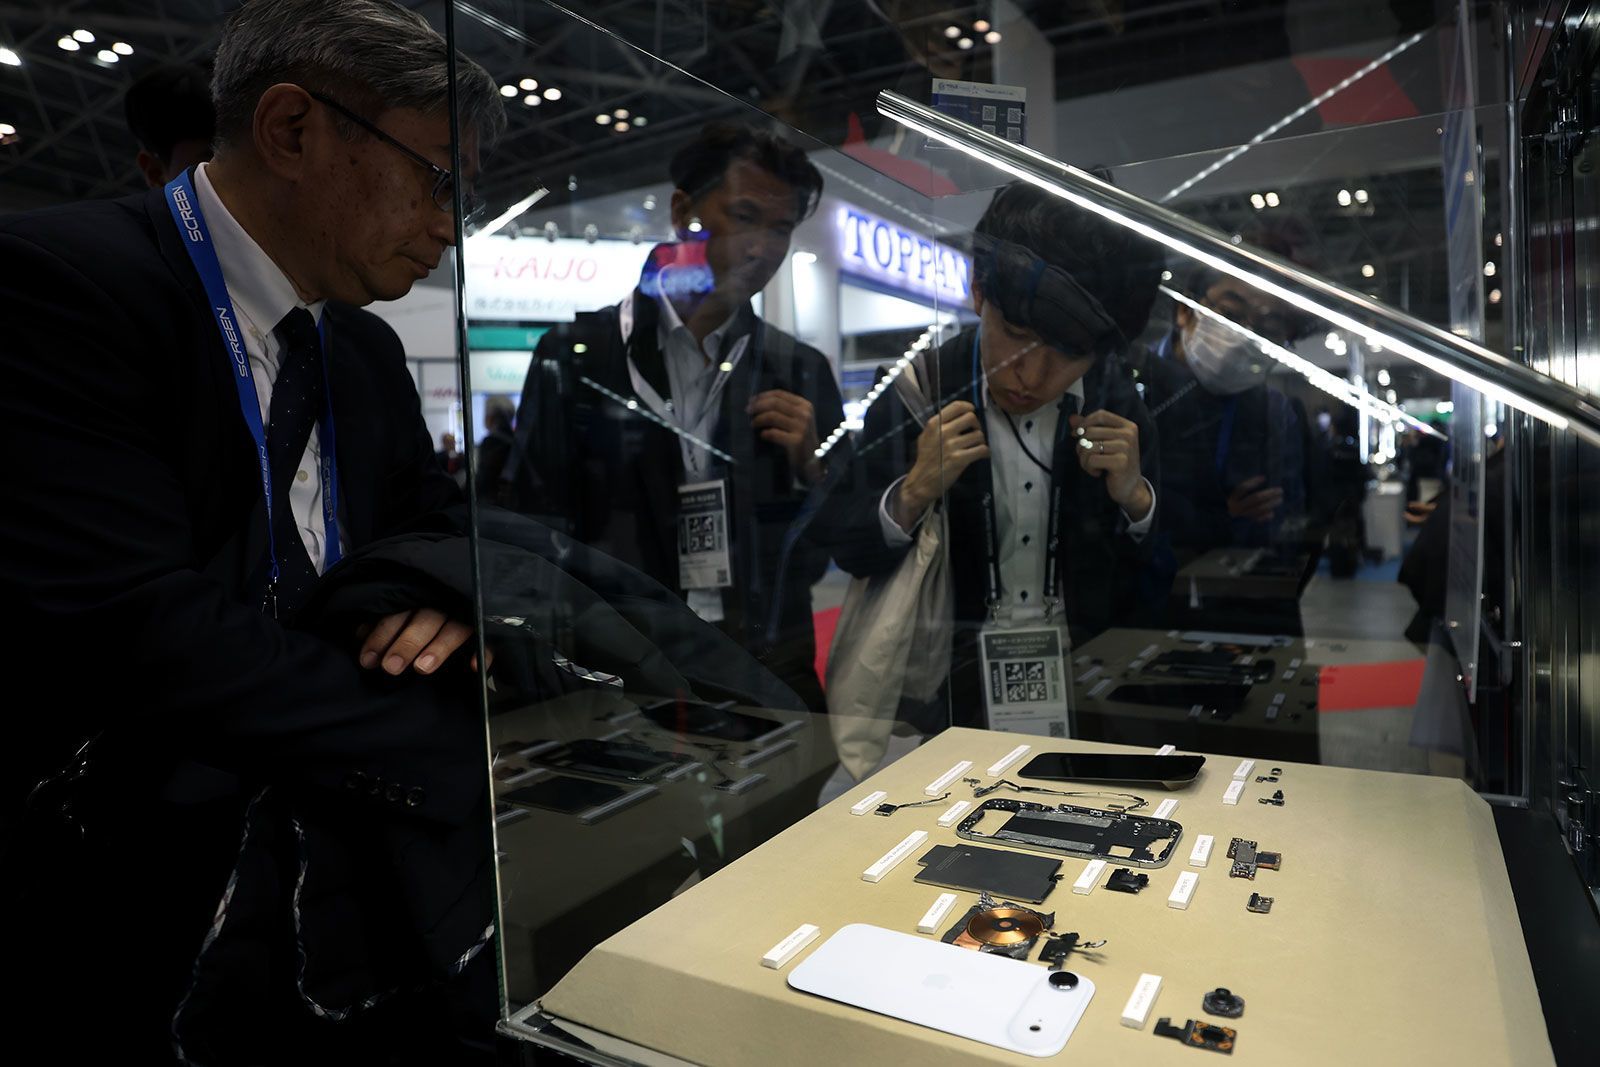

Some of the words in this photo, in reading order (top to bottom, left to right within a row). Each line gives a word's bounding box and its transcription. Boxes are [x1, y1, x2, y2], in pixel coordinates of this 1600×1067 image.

[172, 185, 204, 242] SCREEN
[491, 255, 599, 282] KAIJO
[847, 208, 970, 296] TOPPAN
[216, 307, 249, 378] SCREEN
[322, 456, 335, 522] SCREEN
